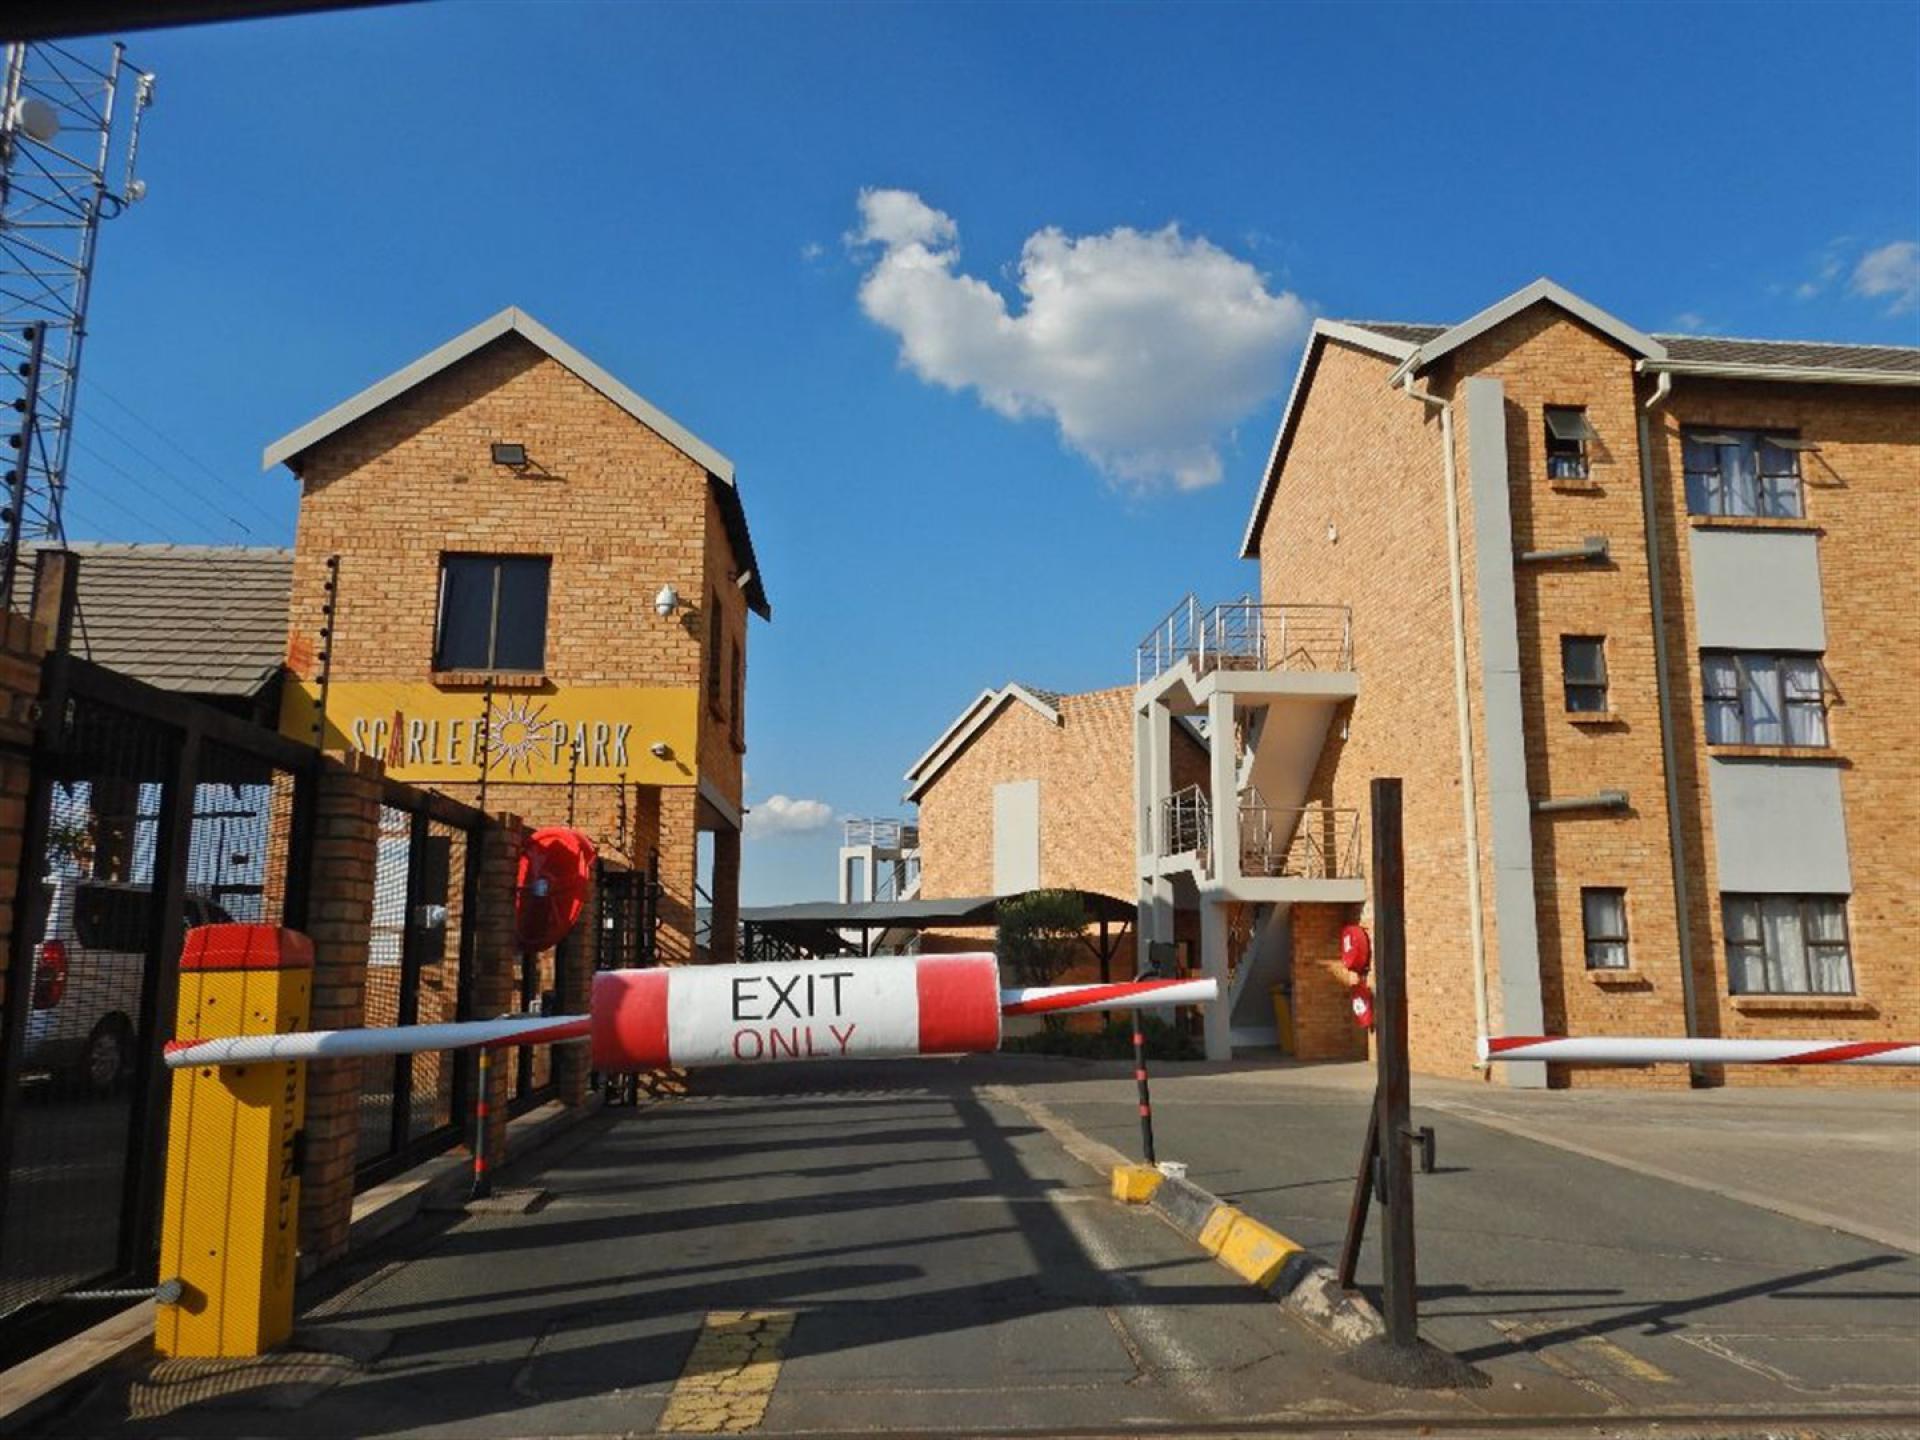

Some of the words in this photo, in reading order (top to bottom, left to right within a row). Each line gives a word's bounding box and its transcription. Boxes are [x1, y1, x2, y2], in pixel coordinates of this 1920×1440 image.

[550, 719, 632, 768] PARK
[731, 972, 855, 1022] EXIT
[732, 1023, 857, 1061] ONLY
[278, 1015, 300, 1232] CENTURIN
